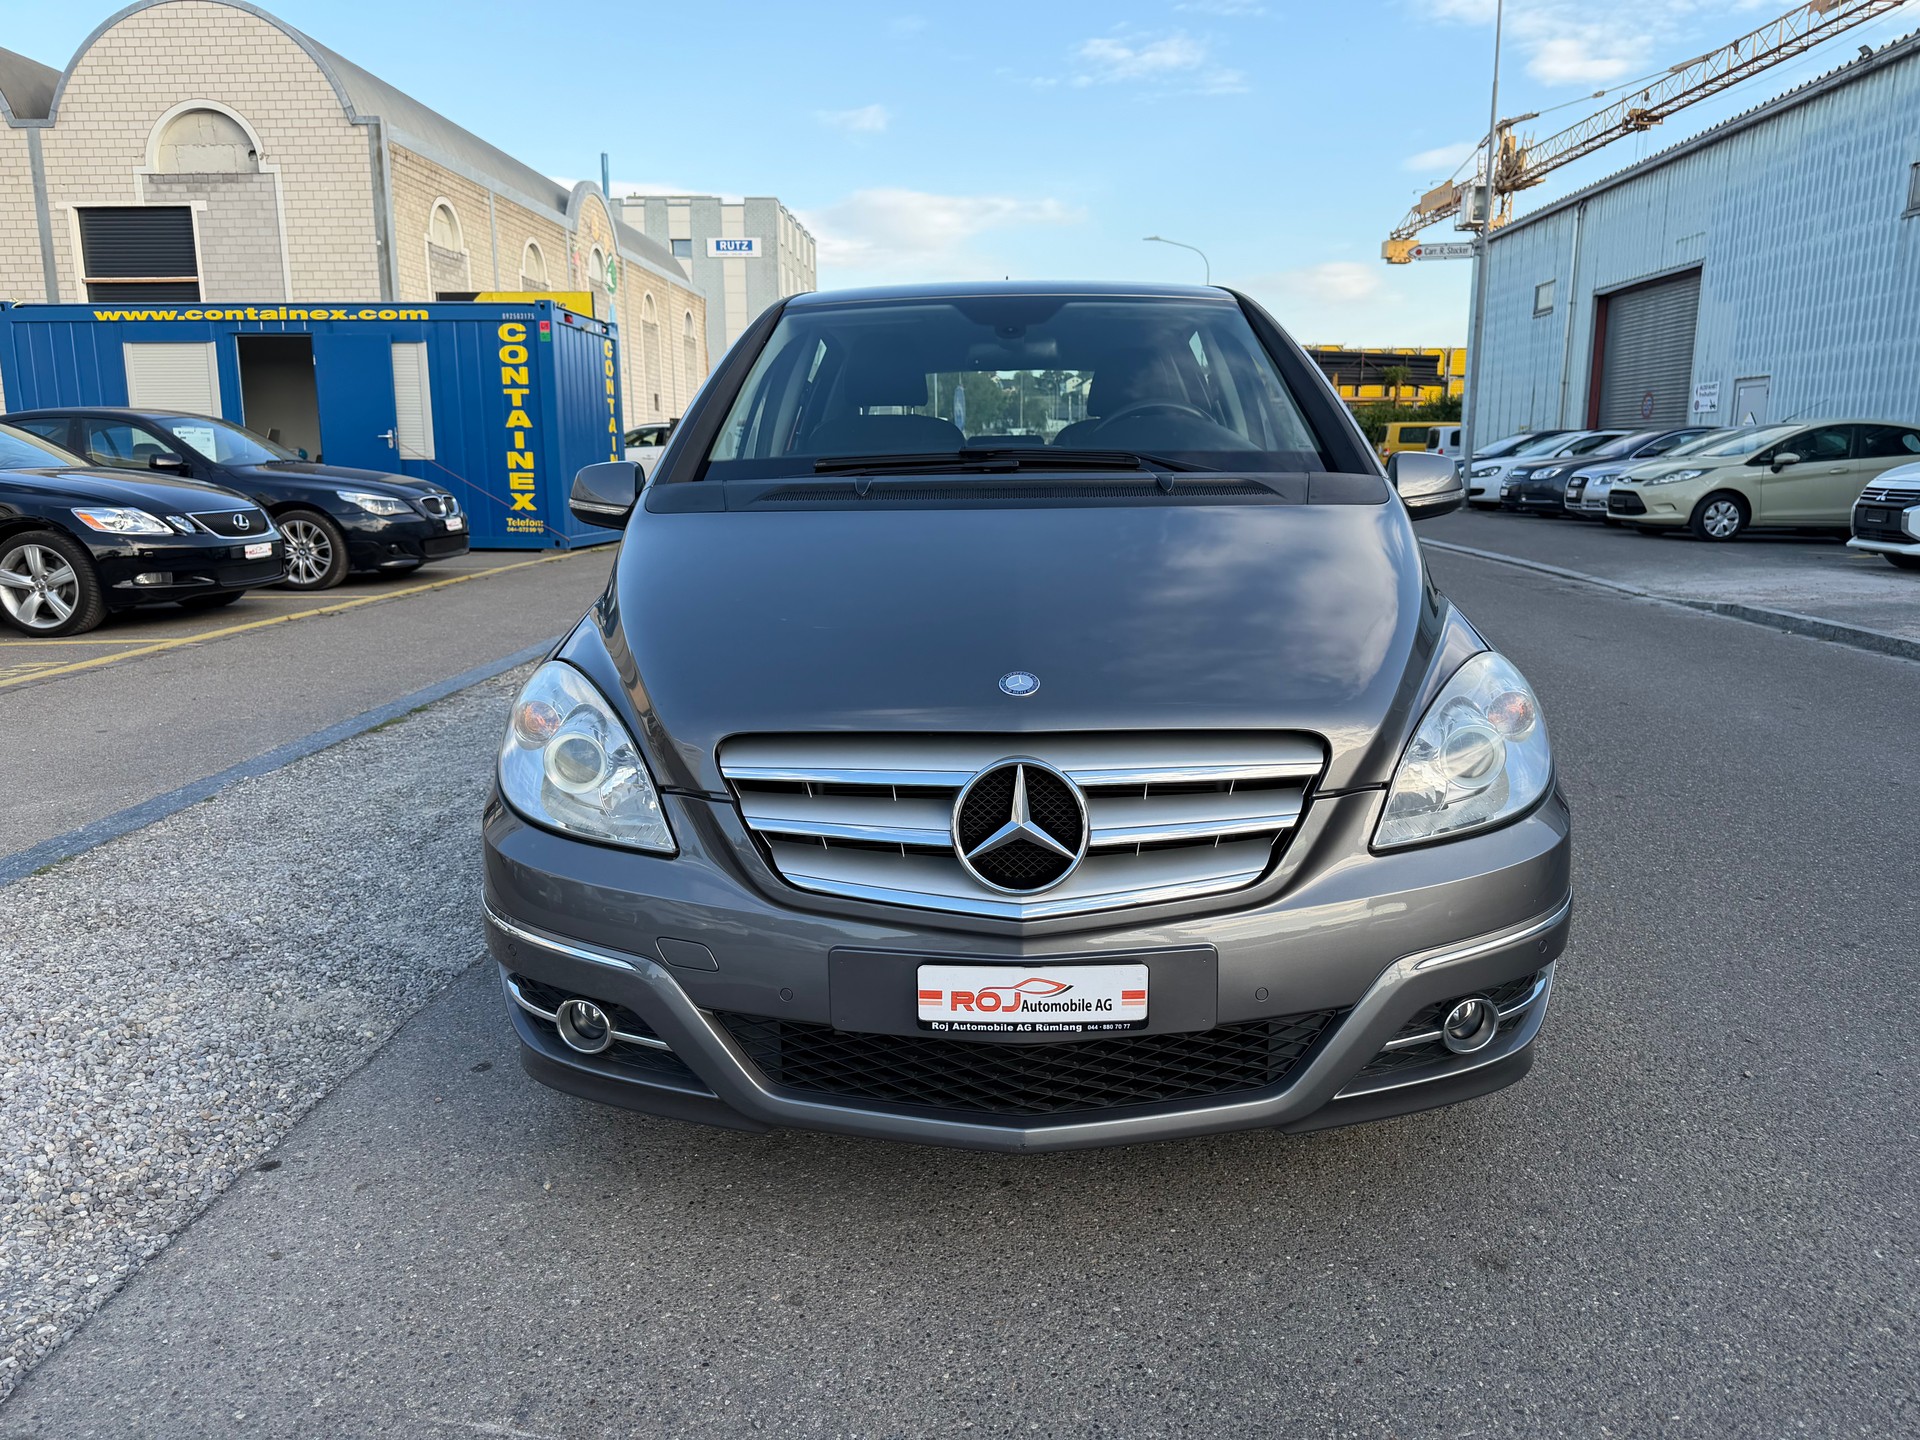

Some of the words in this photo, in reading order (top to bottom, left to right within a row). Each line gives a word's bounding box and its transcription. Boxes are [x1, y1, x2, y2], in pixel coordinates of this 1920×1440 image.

[720, 241, 749, 250] RUTZ
[93, 306, 429, 321] www.containex.com
[498, 322, 538, 511] CONTAINEX
[950, 991, 1021, 1012] ROJ
[1021, 999, 1092, 1013] Automobile
[1095, 998, 1113, 1012] AG
[931, 1022, 949, 1032] Roj
[952, 1022, 1014, 1032] Automobile
[1016, 1023, 1032, 1032] AG
[1035, 1022, 1083, 1032] Rümlang
